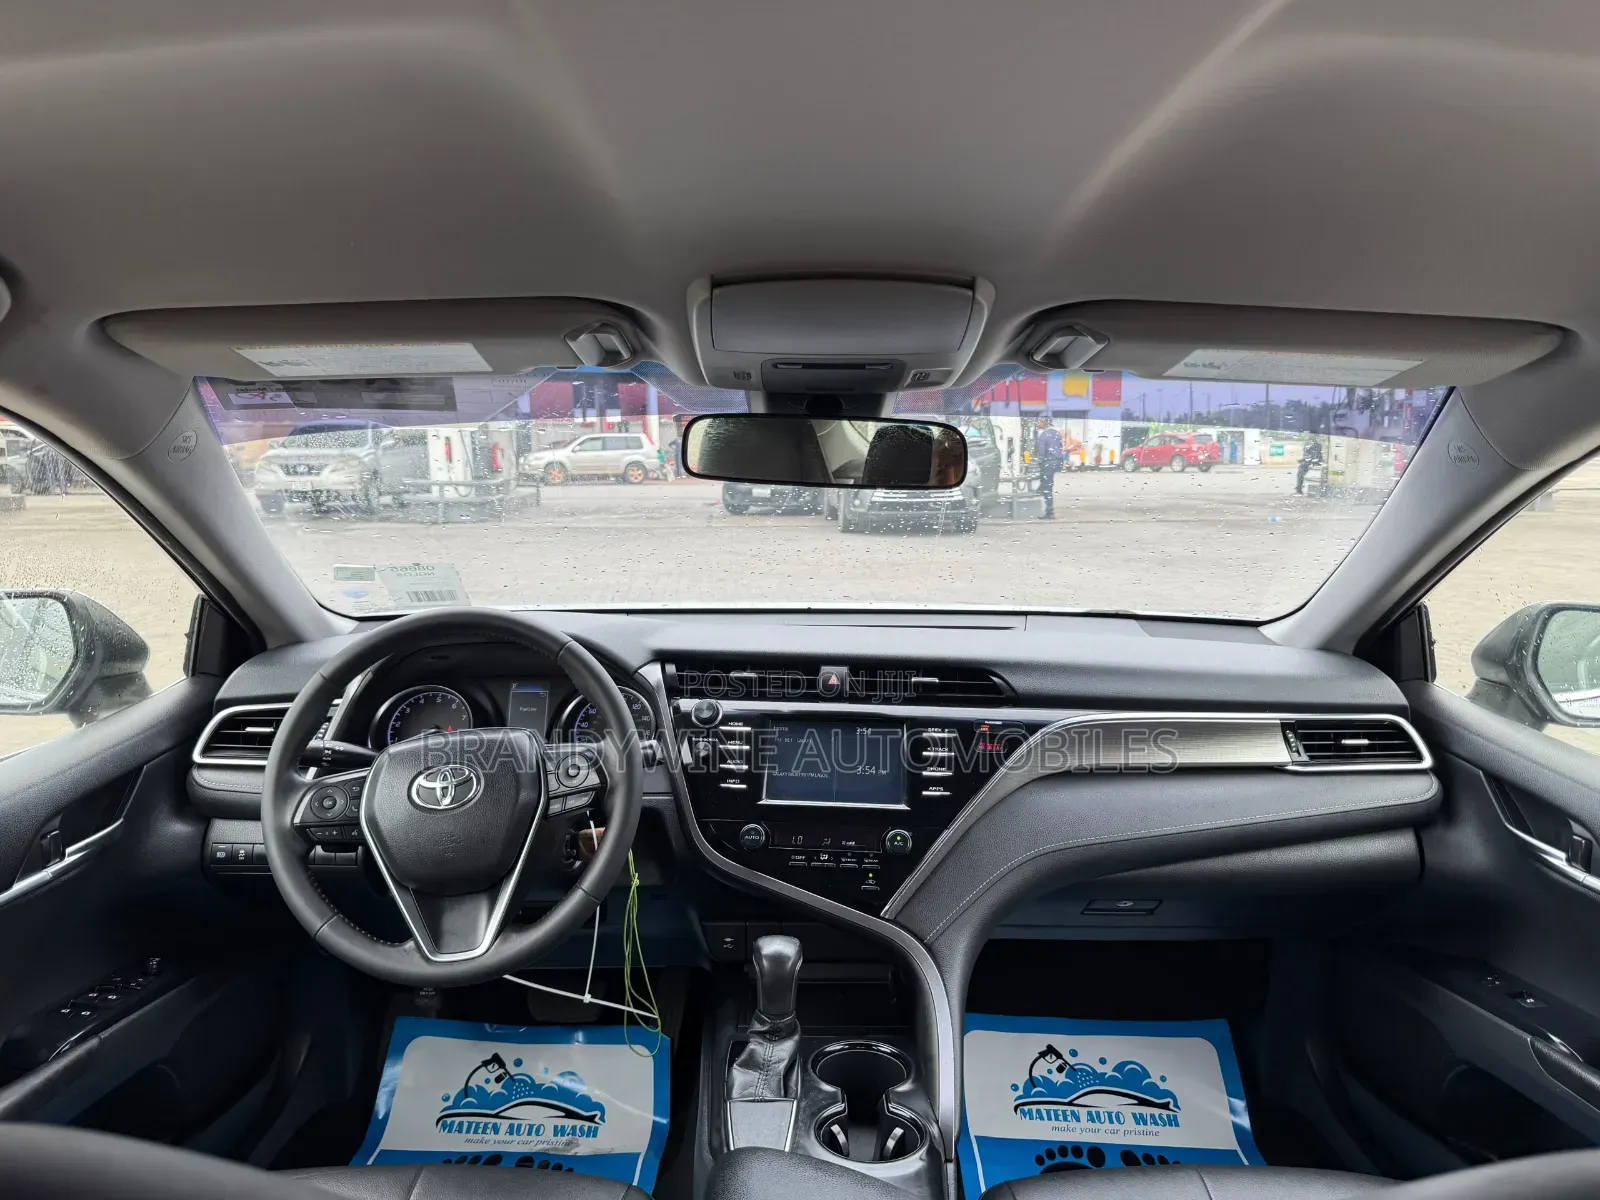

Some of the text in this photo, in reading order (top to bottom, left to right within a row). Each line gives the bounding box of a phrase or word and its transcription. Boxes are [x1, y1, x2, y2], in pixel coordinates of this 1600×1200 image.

[856, 727, 871, 735] 3:54
[857, 765, 876, 775] 3:54
[1018, 1107, 1181, 1128] MATEEN AUTO WASH
[438, 1119, 601, 1138] MATEEN AUTO WASH
[1051, 1124, 1077, 1133] make
[1078, 1126, 1101, 1135] your
[1123, 1126, 1160, 1137] pristine
[464, 1137, 491, 1145] make
[492, 1138, 515, 1147] your
[534, 1138, 573, 1147] pristine
